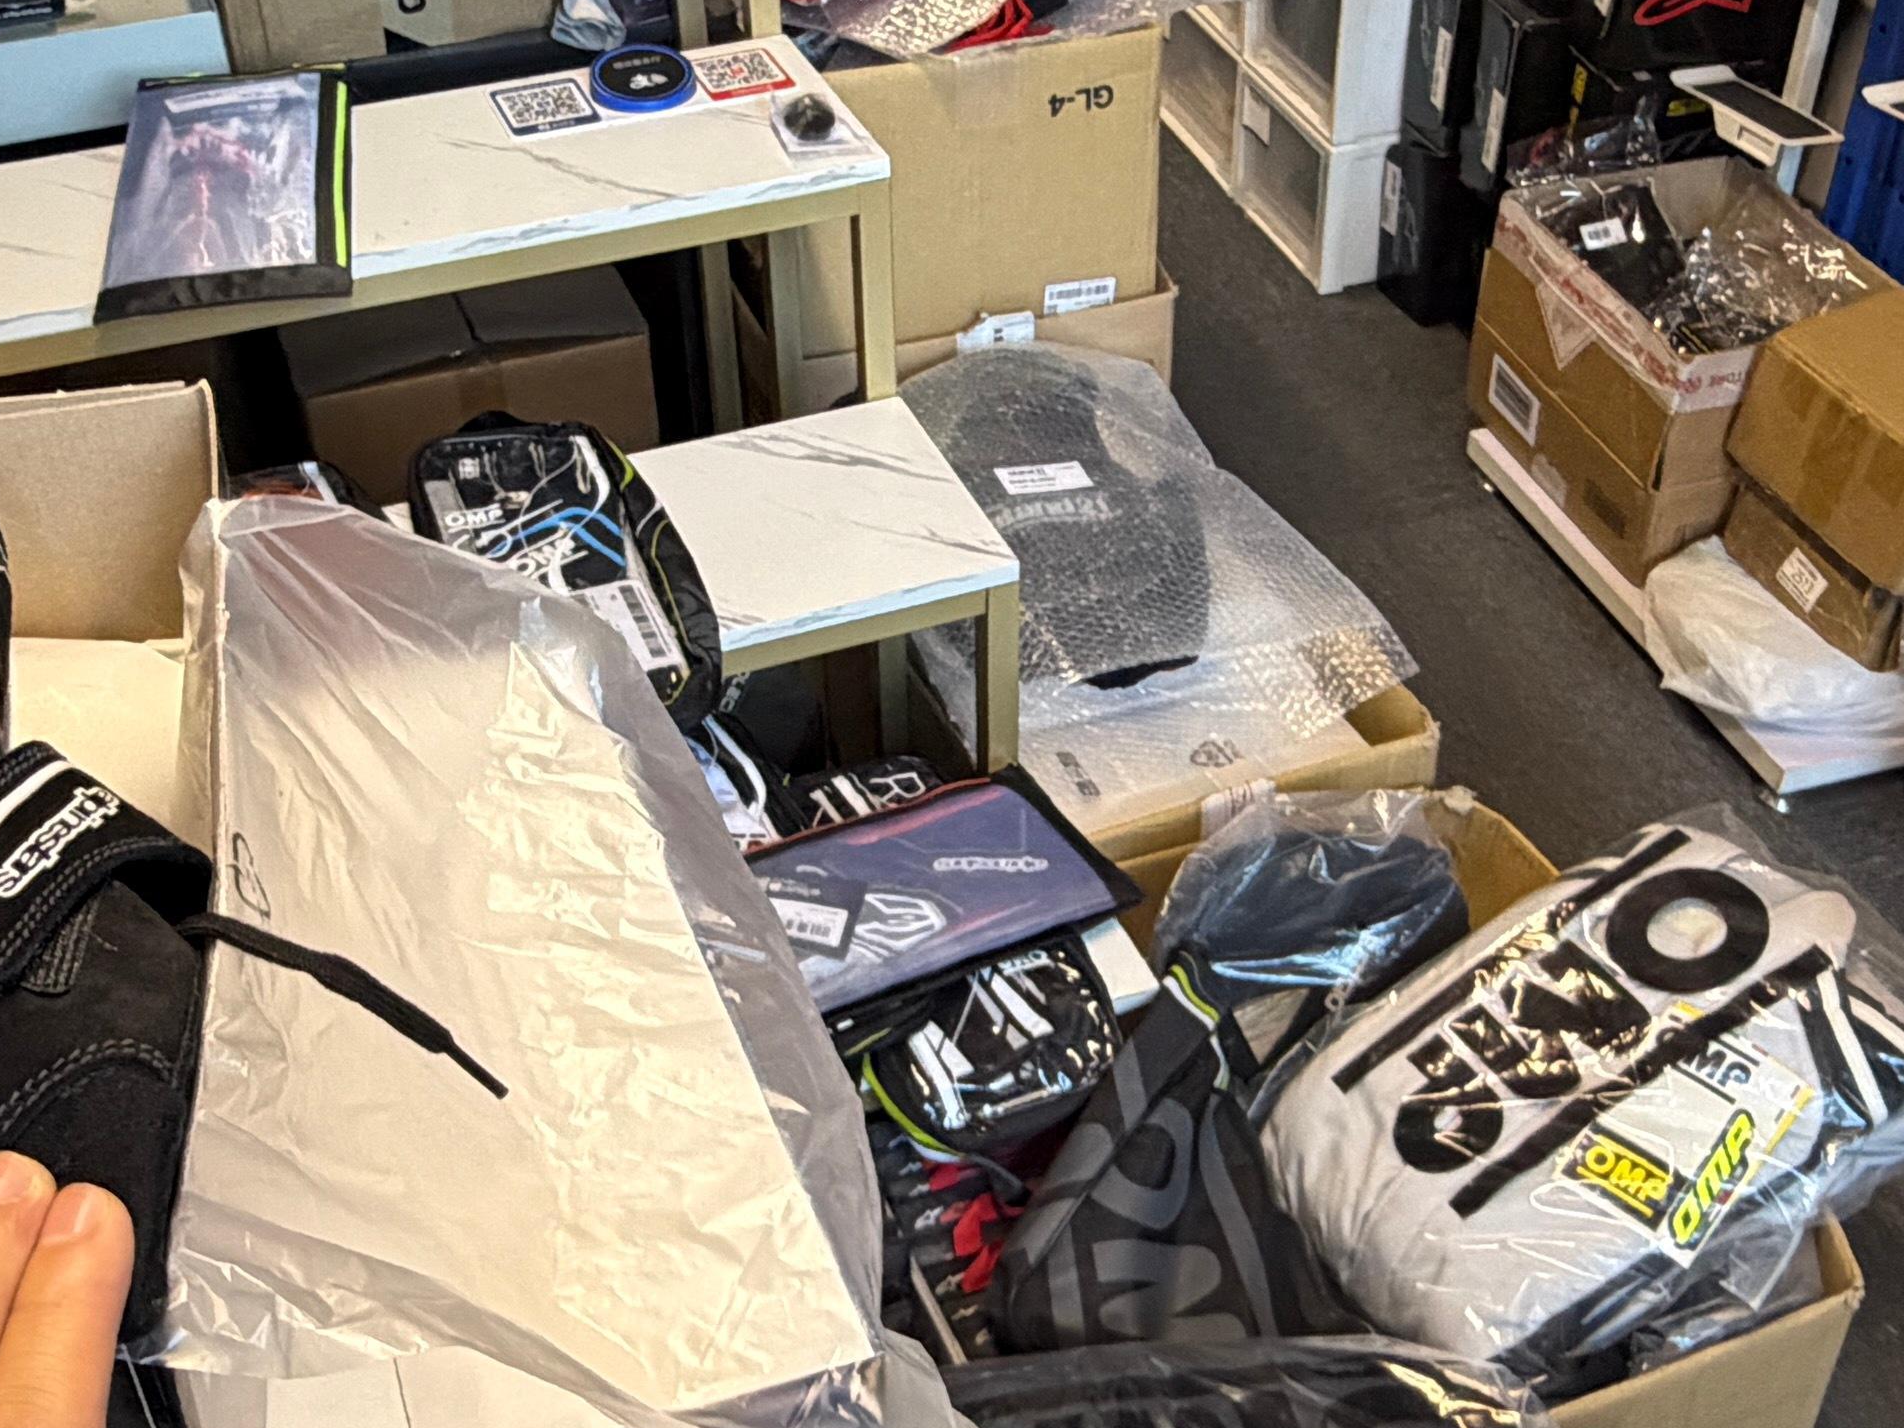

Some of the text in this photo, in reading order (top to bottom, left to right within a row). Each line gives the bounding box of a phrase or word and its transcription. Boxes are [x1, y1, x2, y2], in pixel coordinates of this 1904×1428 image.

[1047, 83, 1115, 119] GL-4
[444, 505, 504, 527] OMP
[1585, 1145, 1669, 1202] OMP
